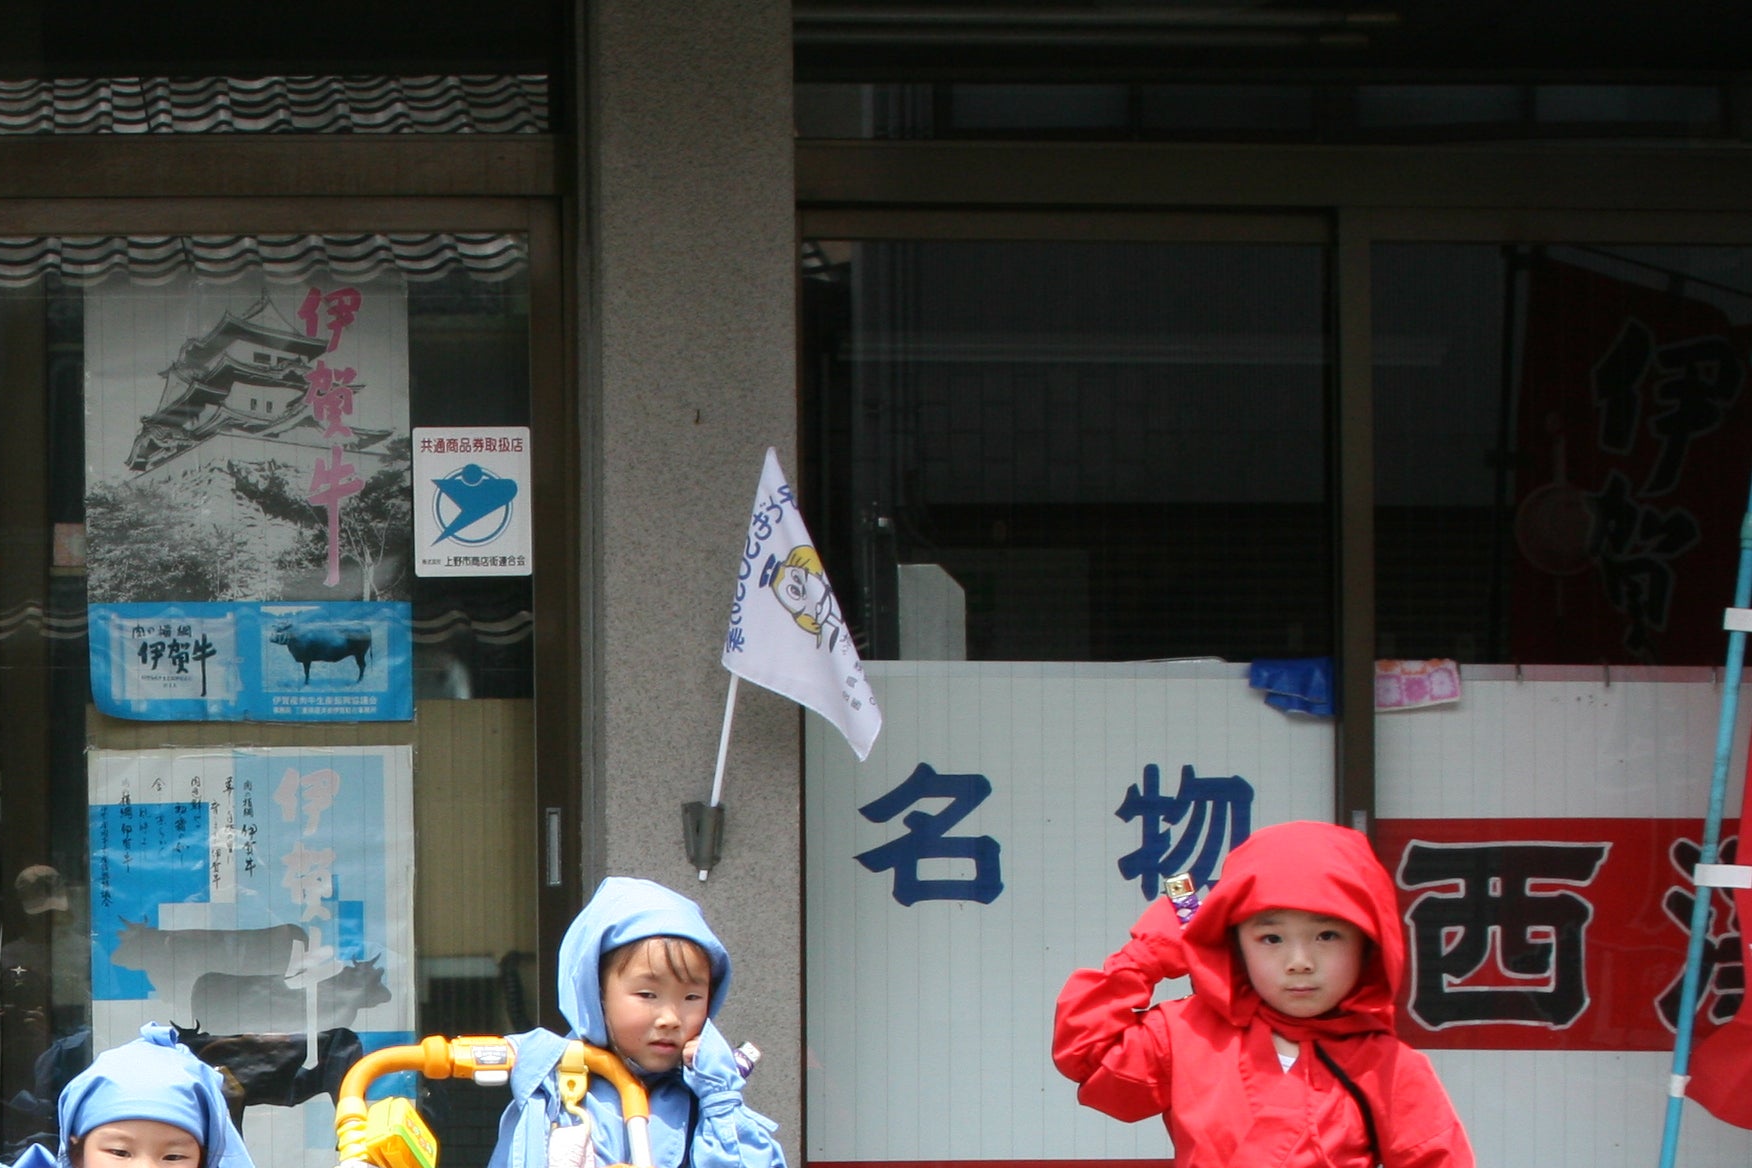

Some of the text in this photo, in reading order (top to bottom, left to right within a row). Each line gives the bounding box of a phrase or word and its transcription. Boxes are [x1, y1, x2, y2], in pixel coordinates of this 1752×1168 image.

[296, 286, 366, 588] 伊賀牛
[421, 437, 524, 453] 共通商品券取扱店
[138, 633, 217, 697] 伊賀牛
[853, 761, 1256, 908] 名物
[272, 767, 342, 1070] 伊賀牛
